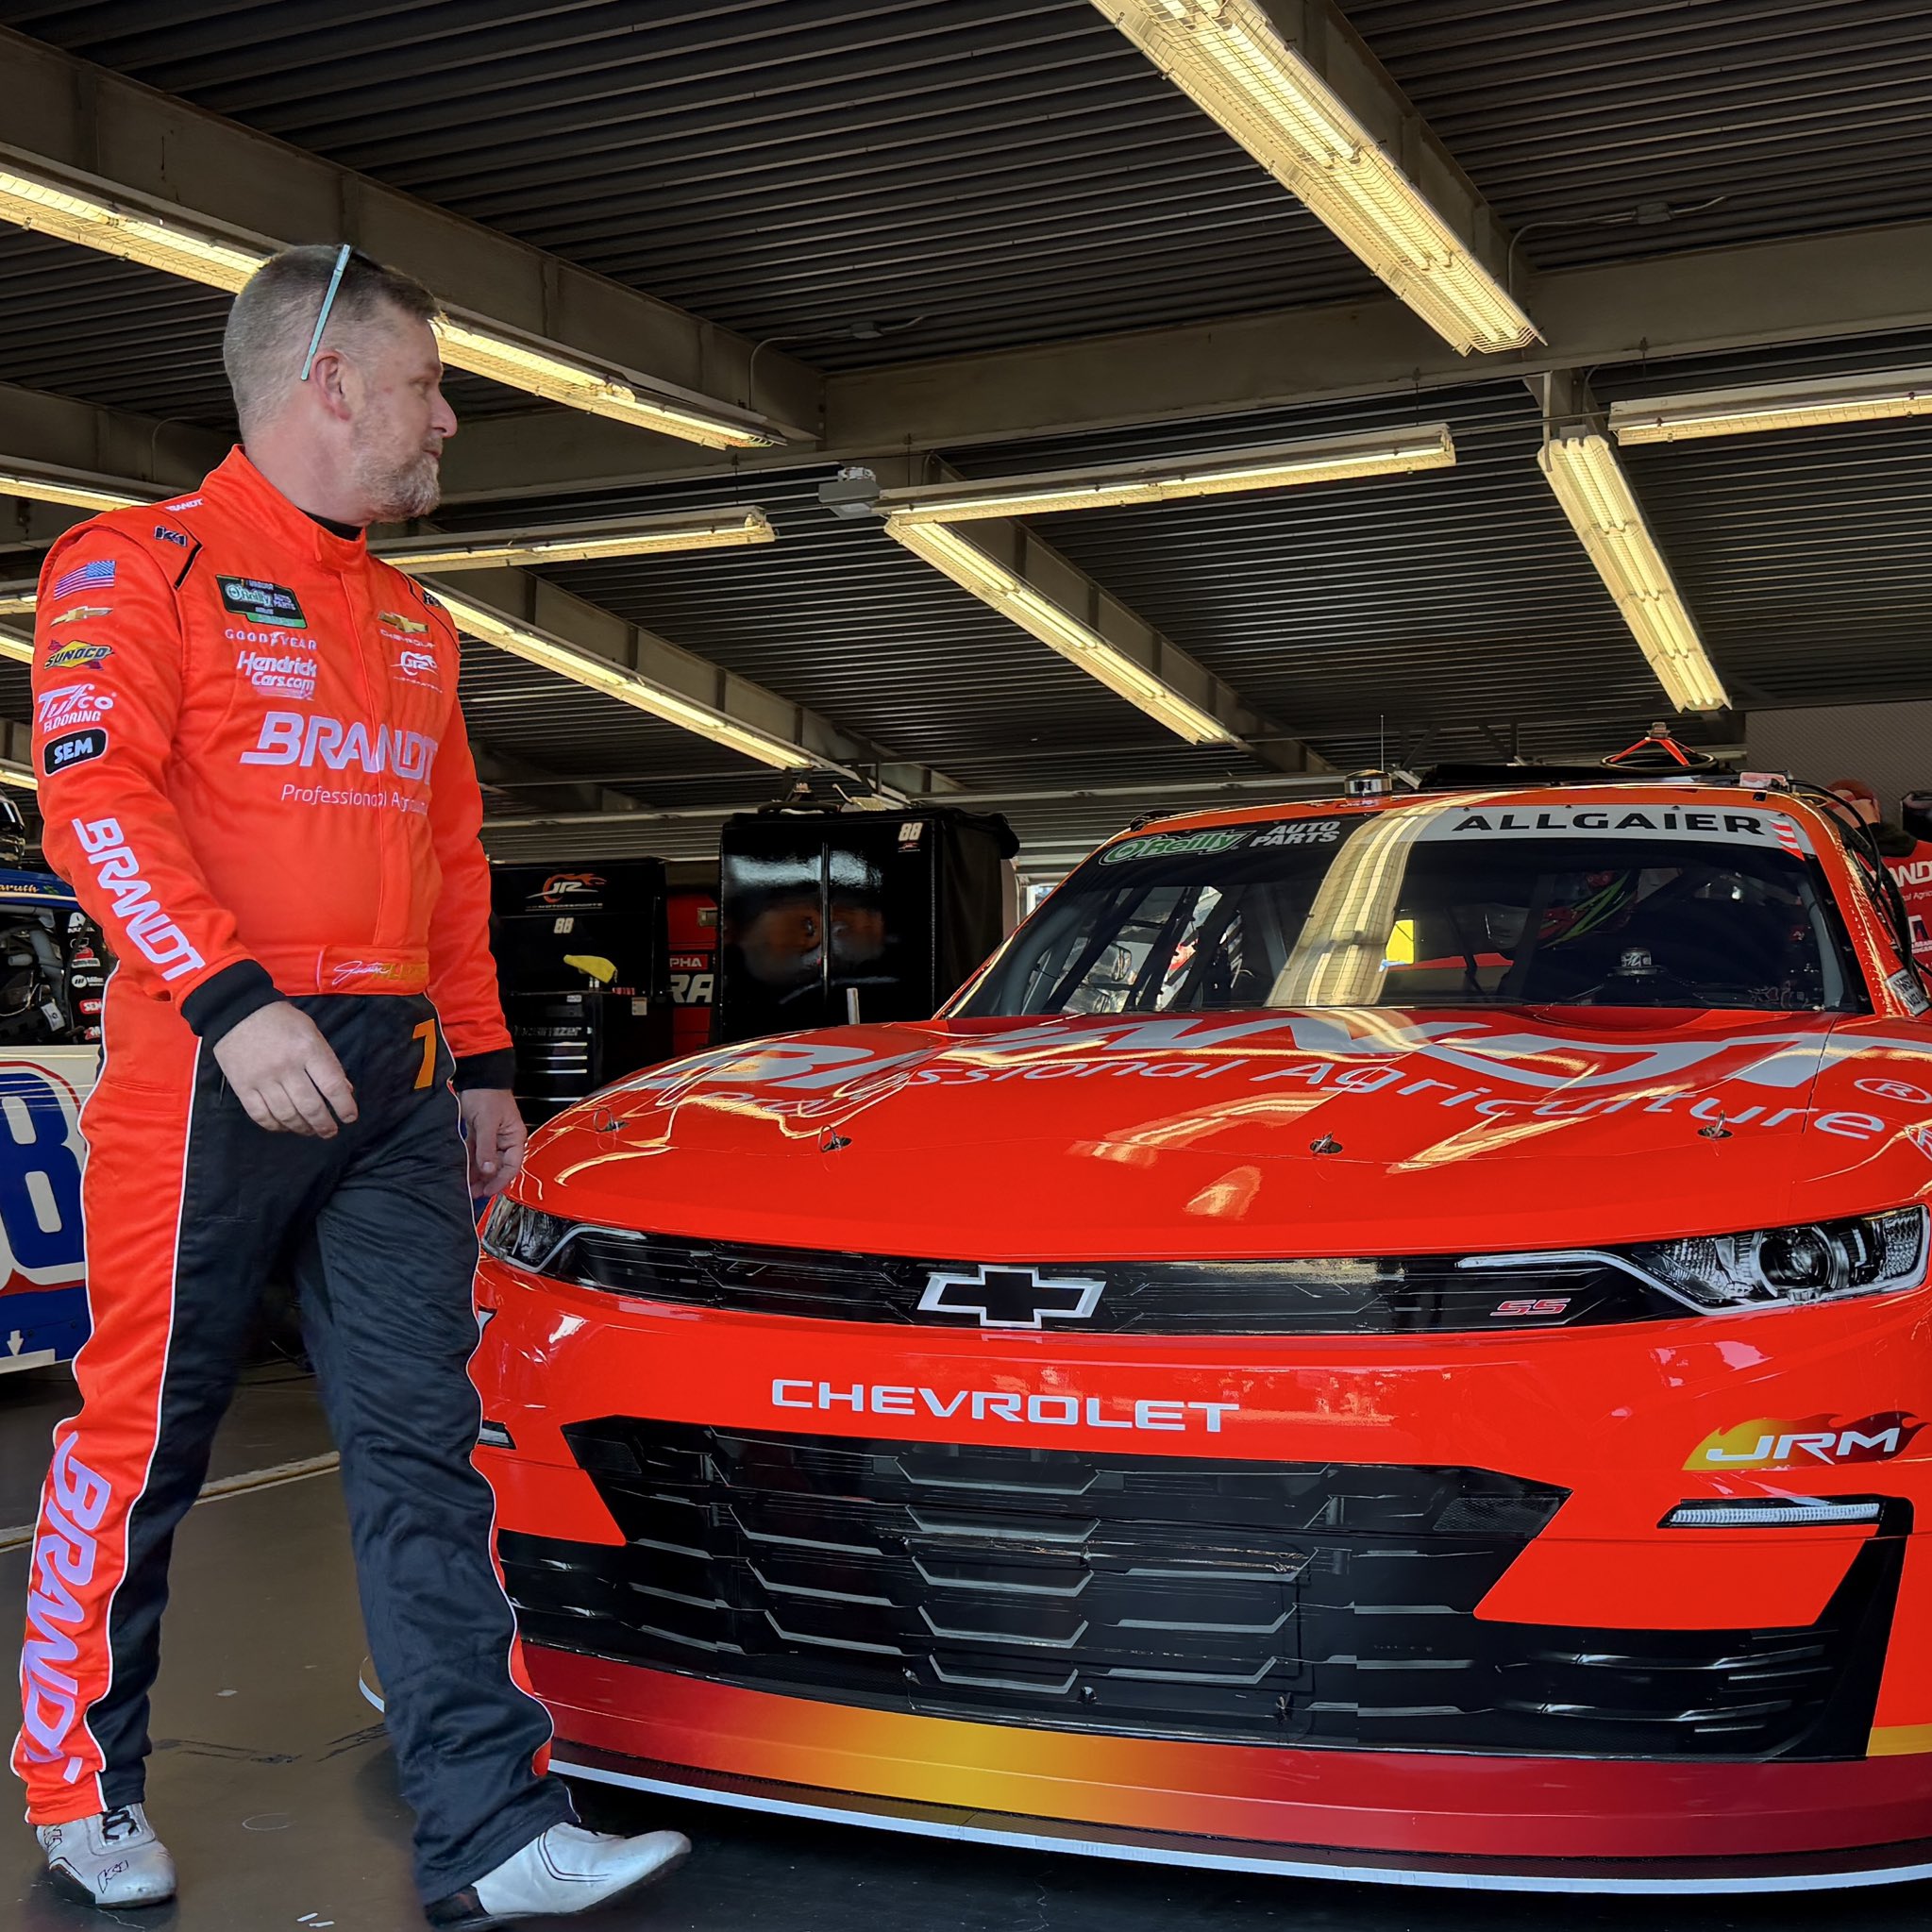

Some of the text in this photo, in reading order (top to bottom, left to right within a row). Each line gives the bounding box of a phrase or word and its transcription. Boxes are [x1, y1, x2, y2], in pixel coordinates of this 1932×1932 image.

[44, 646, 112, 670] SUNOCO
[236, 650, 318, 677] Hendrick
[43, 710, 101, 734] FLOORING
[54, 737, 93, 764] SEM
[240, 711, 438, 785] BRANDT
[898, 822, 923, 841] 88
[1266, 821, 1341, 836] AUTO
[1453, 813, 1766, 836] ALLGAIER
[1102, 831, 1248, 864] O'Reilly
[1249, 831, 1341, 848] PARTS
[71, 817, 206, 982] BRANDT
[554, 917, 574, 933] 88
[412, 1017, 437, 1089] 7
[1249, 1062, 1886, 1141] Agriculture
[1490, 1298, 1571, 1317] SS
[772, 1379, 1240, 1435] CHEVROLET
[1705, 1426, 1901, 1467] JRM
